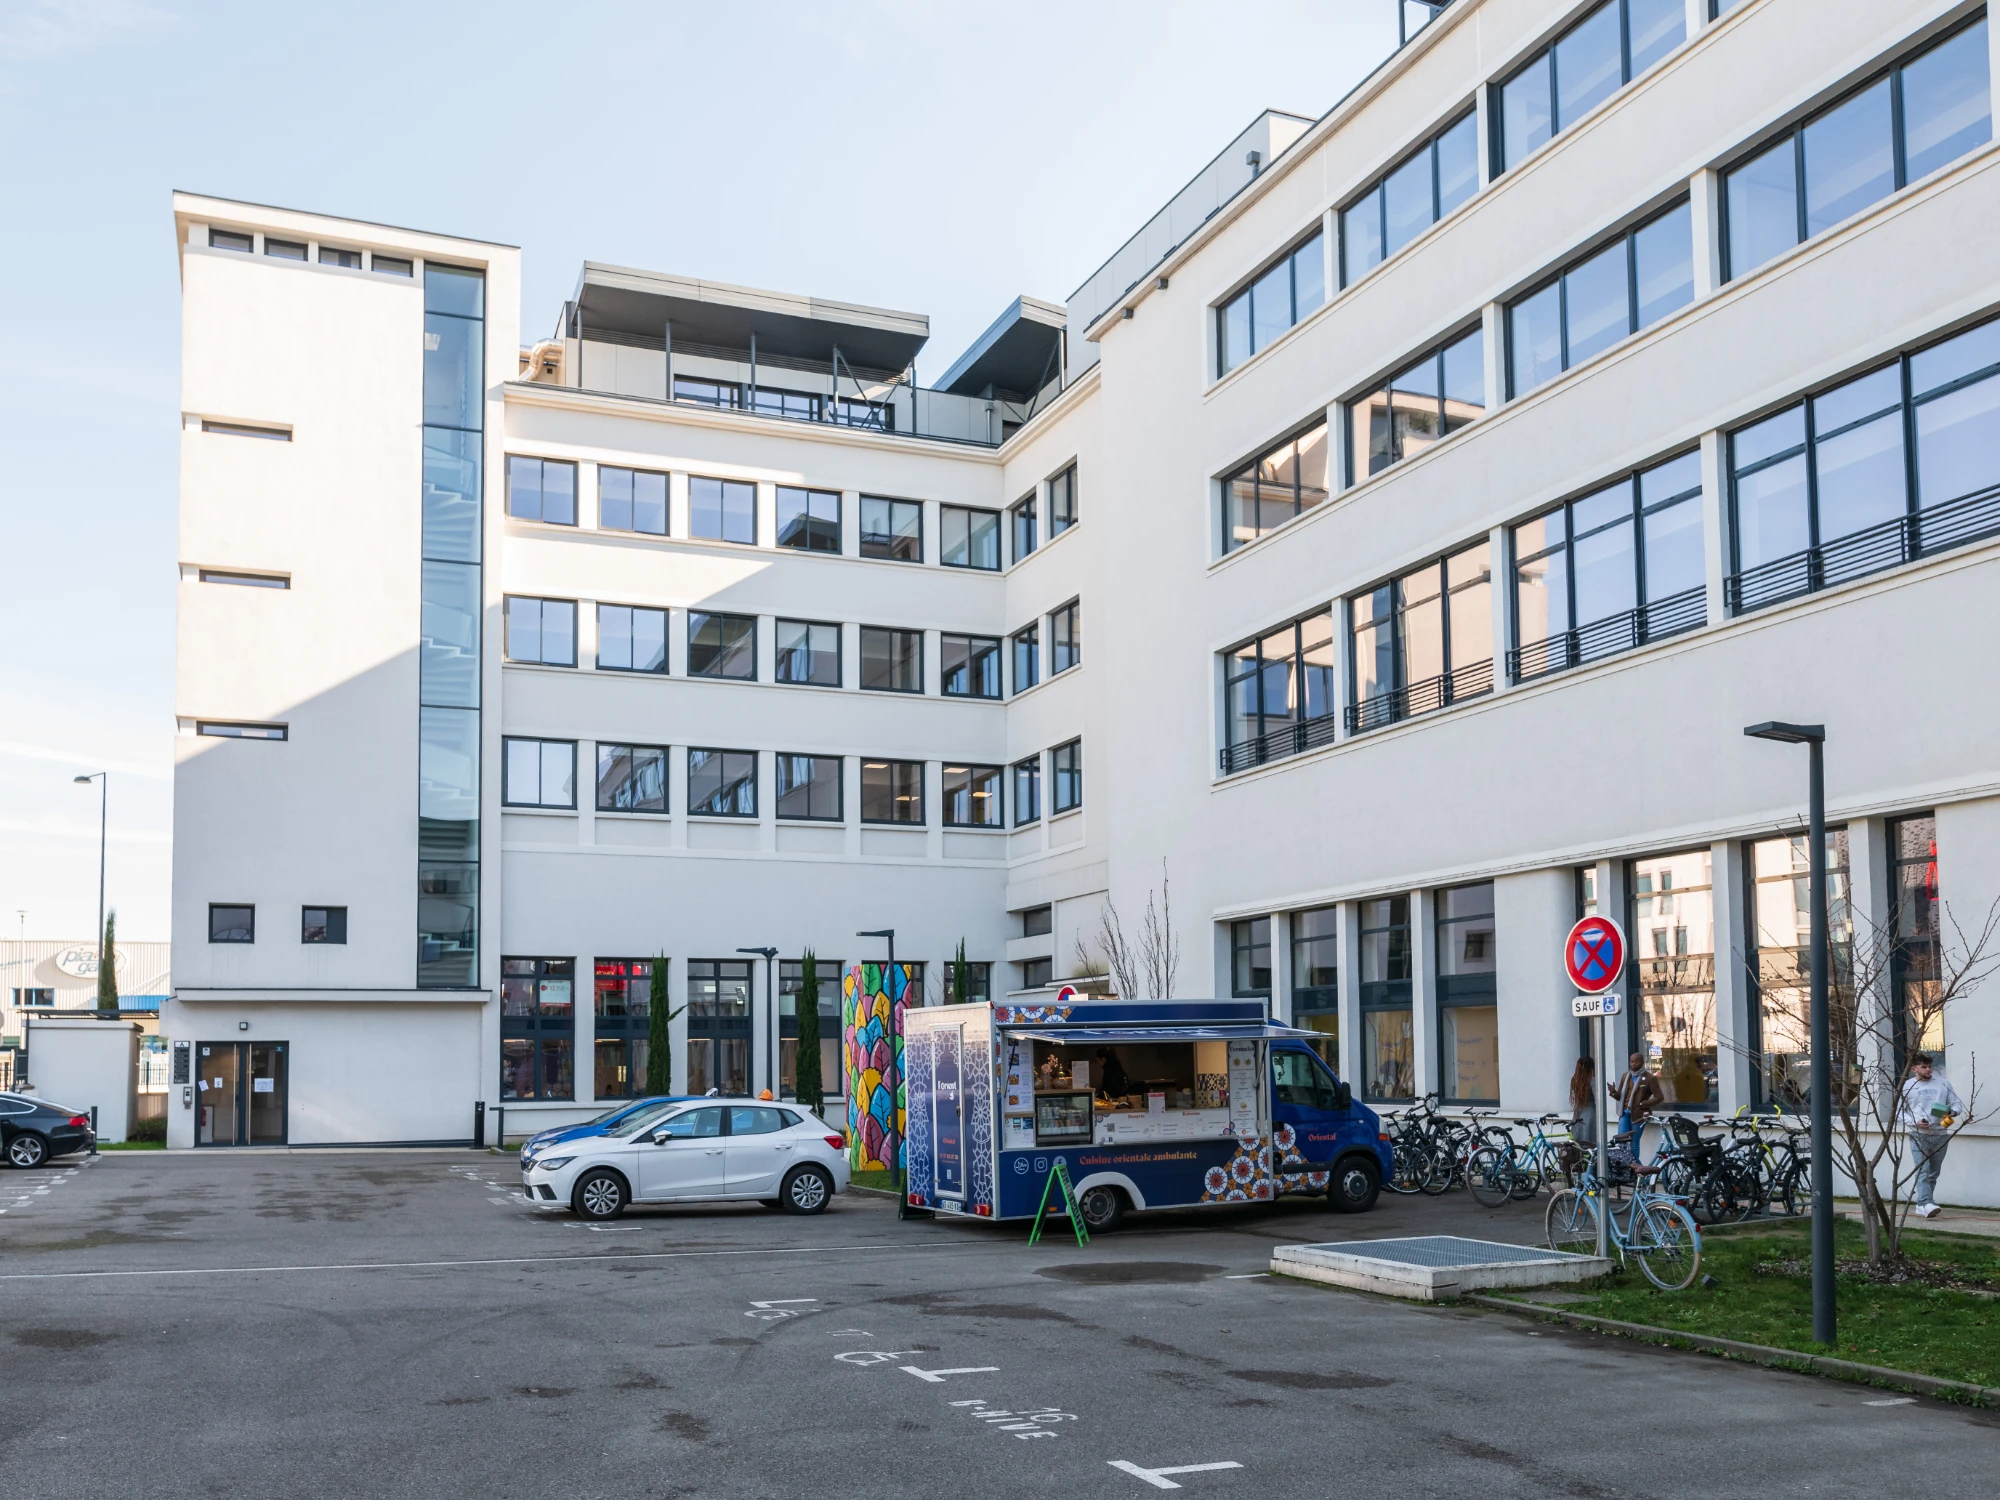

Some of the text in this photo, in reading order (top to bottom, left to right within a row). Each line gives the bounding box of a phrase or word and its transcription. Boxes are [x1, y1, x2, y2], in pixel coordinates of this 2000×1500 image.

[1575, 1001, 1600, 1012] SAUF
[1308, 1133, 1337, 1142] Oriental
[1079, 1151, 1197, 1165] Cuisine orientale ambulante
[1017, 1407, 1079, 1423] 16
